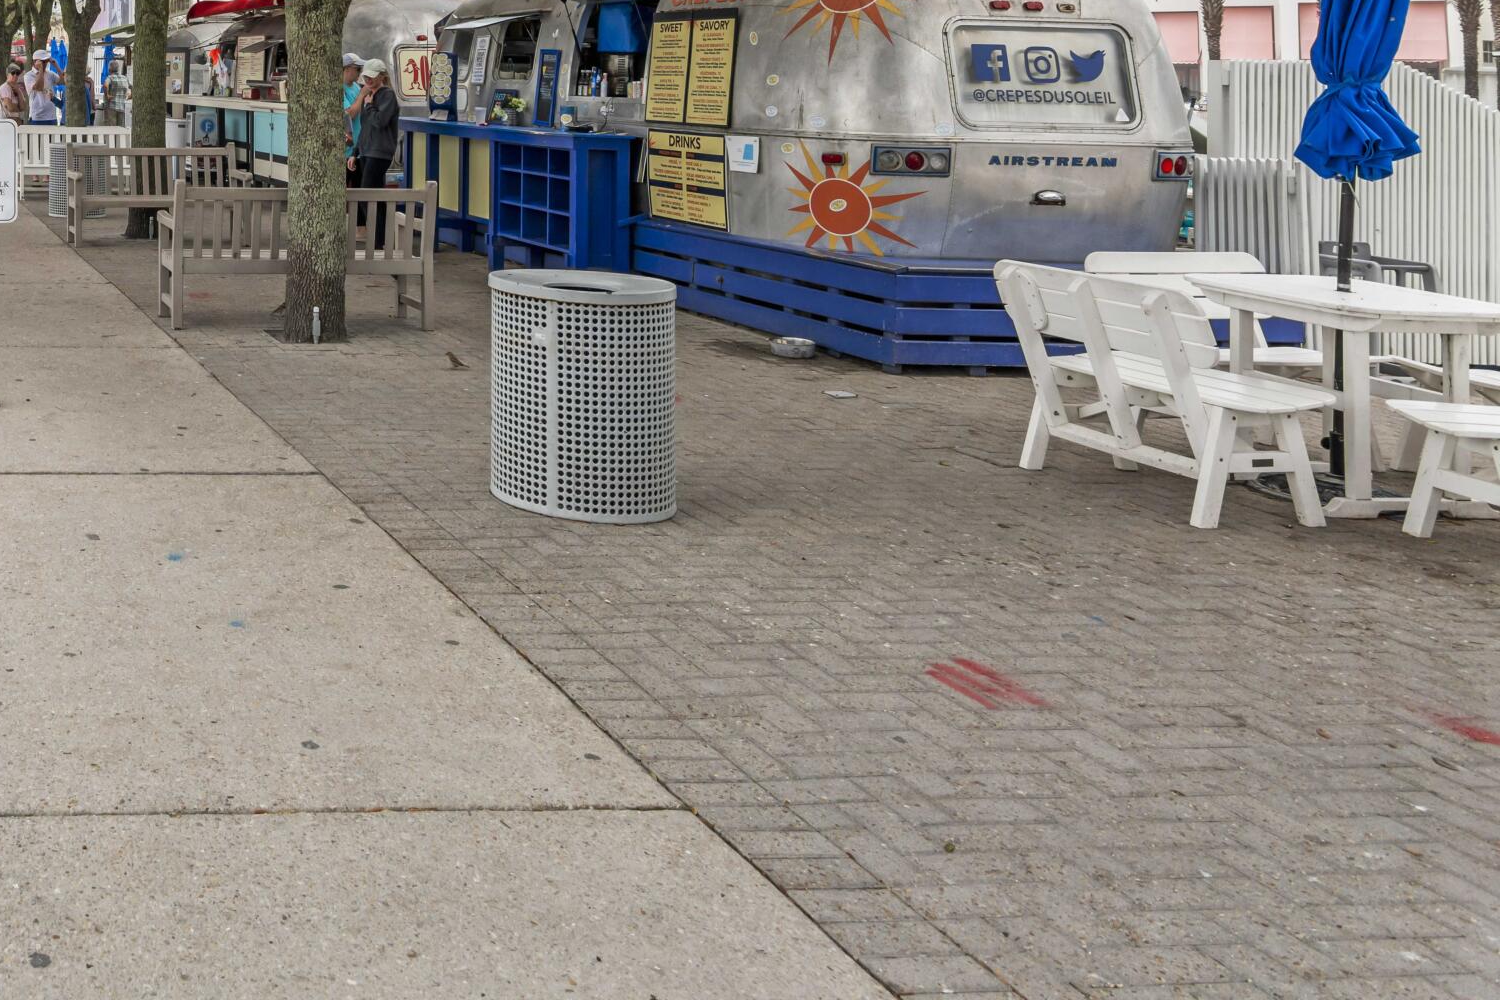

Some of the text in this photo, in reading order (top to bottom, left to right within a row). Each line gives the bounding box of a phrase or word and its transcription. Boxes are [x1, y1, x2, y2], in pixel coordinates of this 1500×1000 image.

[660, 20, 730, 33] SWEET SAVORY
[973, 88, 1116, 105] @CREPESDUSOLEIL
[668, 135, 701, 150] DRINKS
[988, 155, 1118, 168] AIRSTREAM
